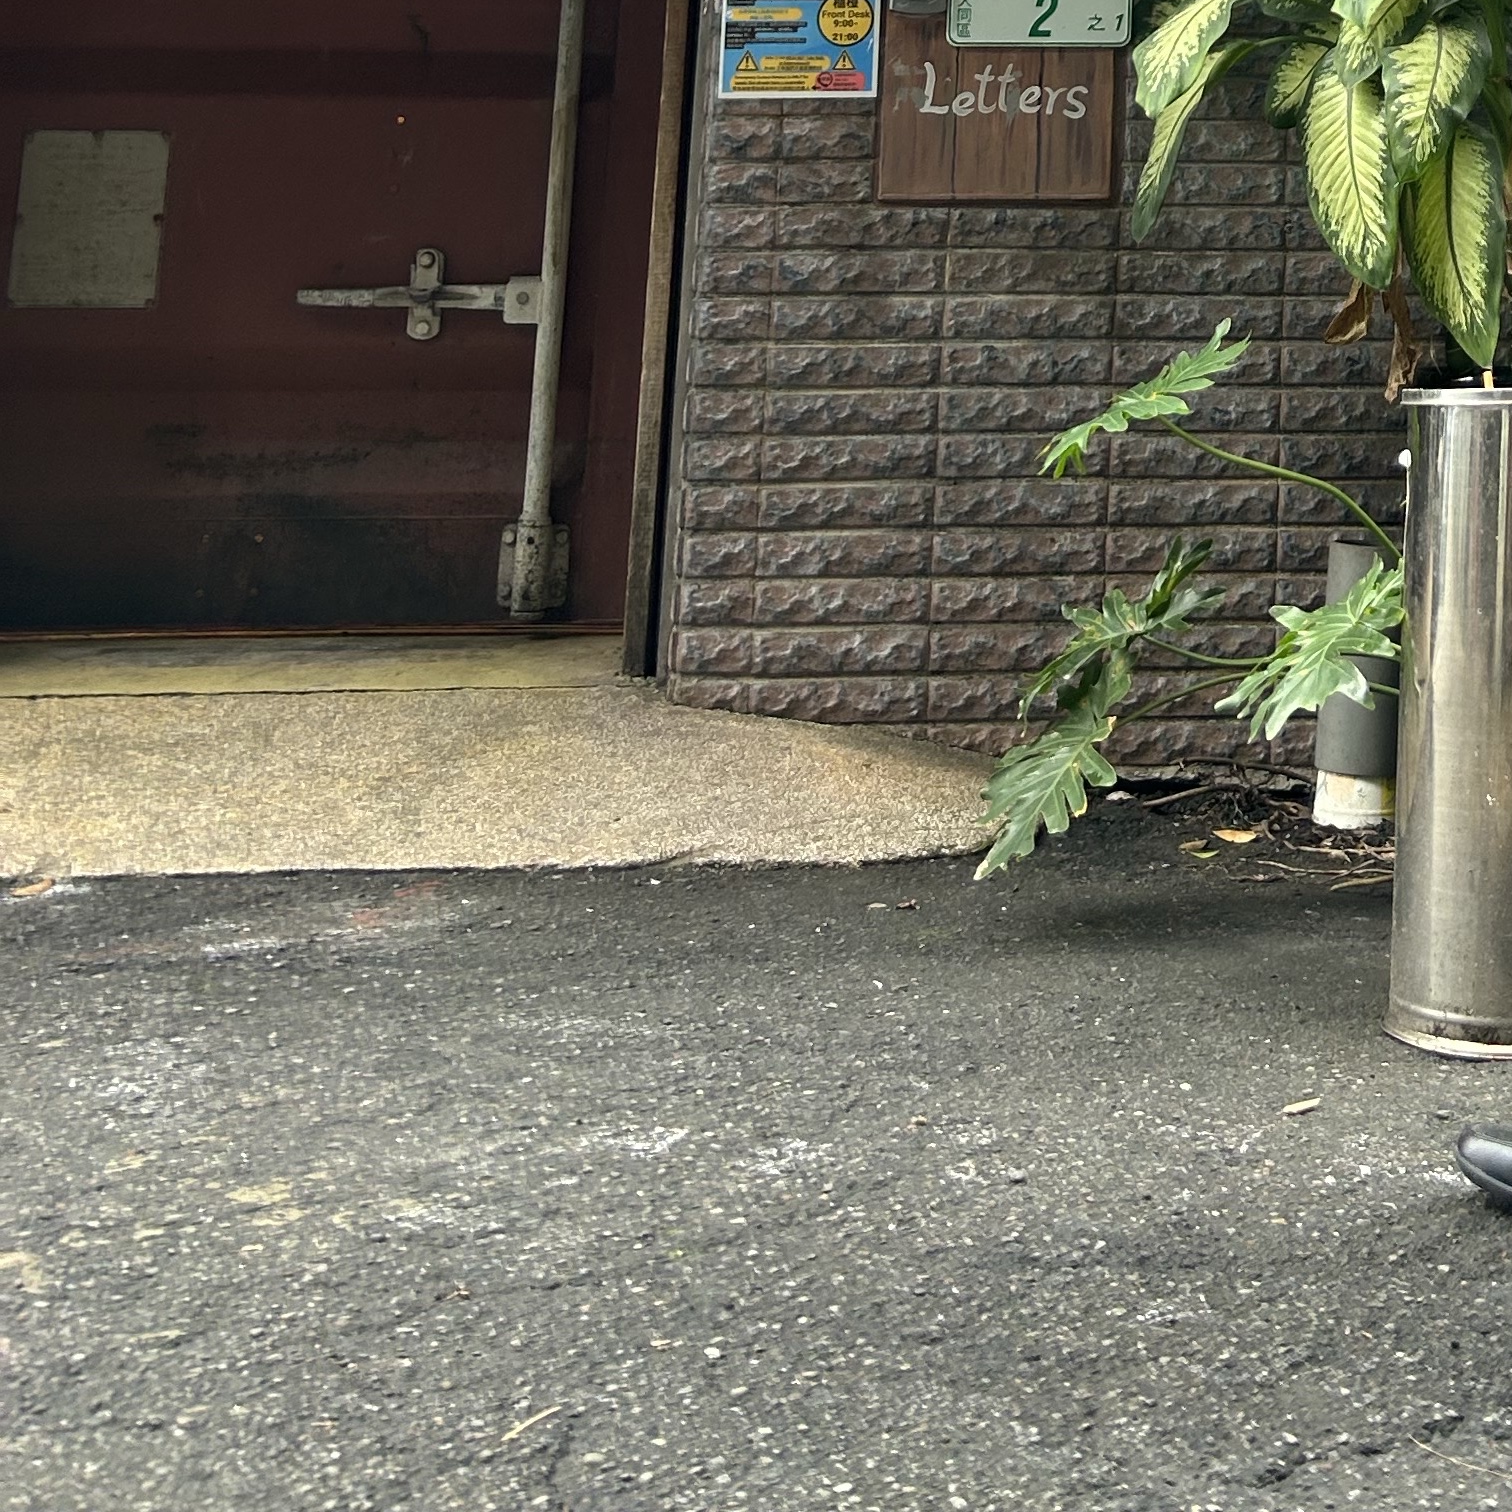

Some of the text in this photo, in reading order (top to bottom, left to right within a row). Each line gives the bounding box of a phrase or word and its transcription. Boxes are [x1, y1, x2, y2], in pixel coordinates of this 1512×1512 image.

[821, 10, 871, 19] Front Desk
[832, 32, 859, 41] 21:00
[918, 60, 1090, 120] Letters
